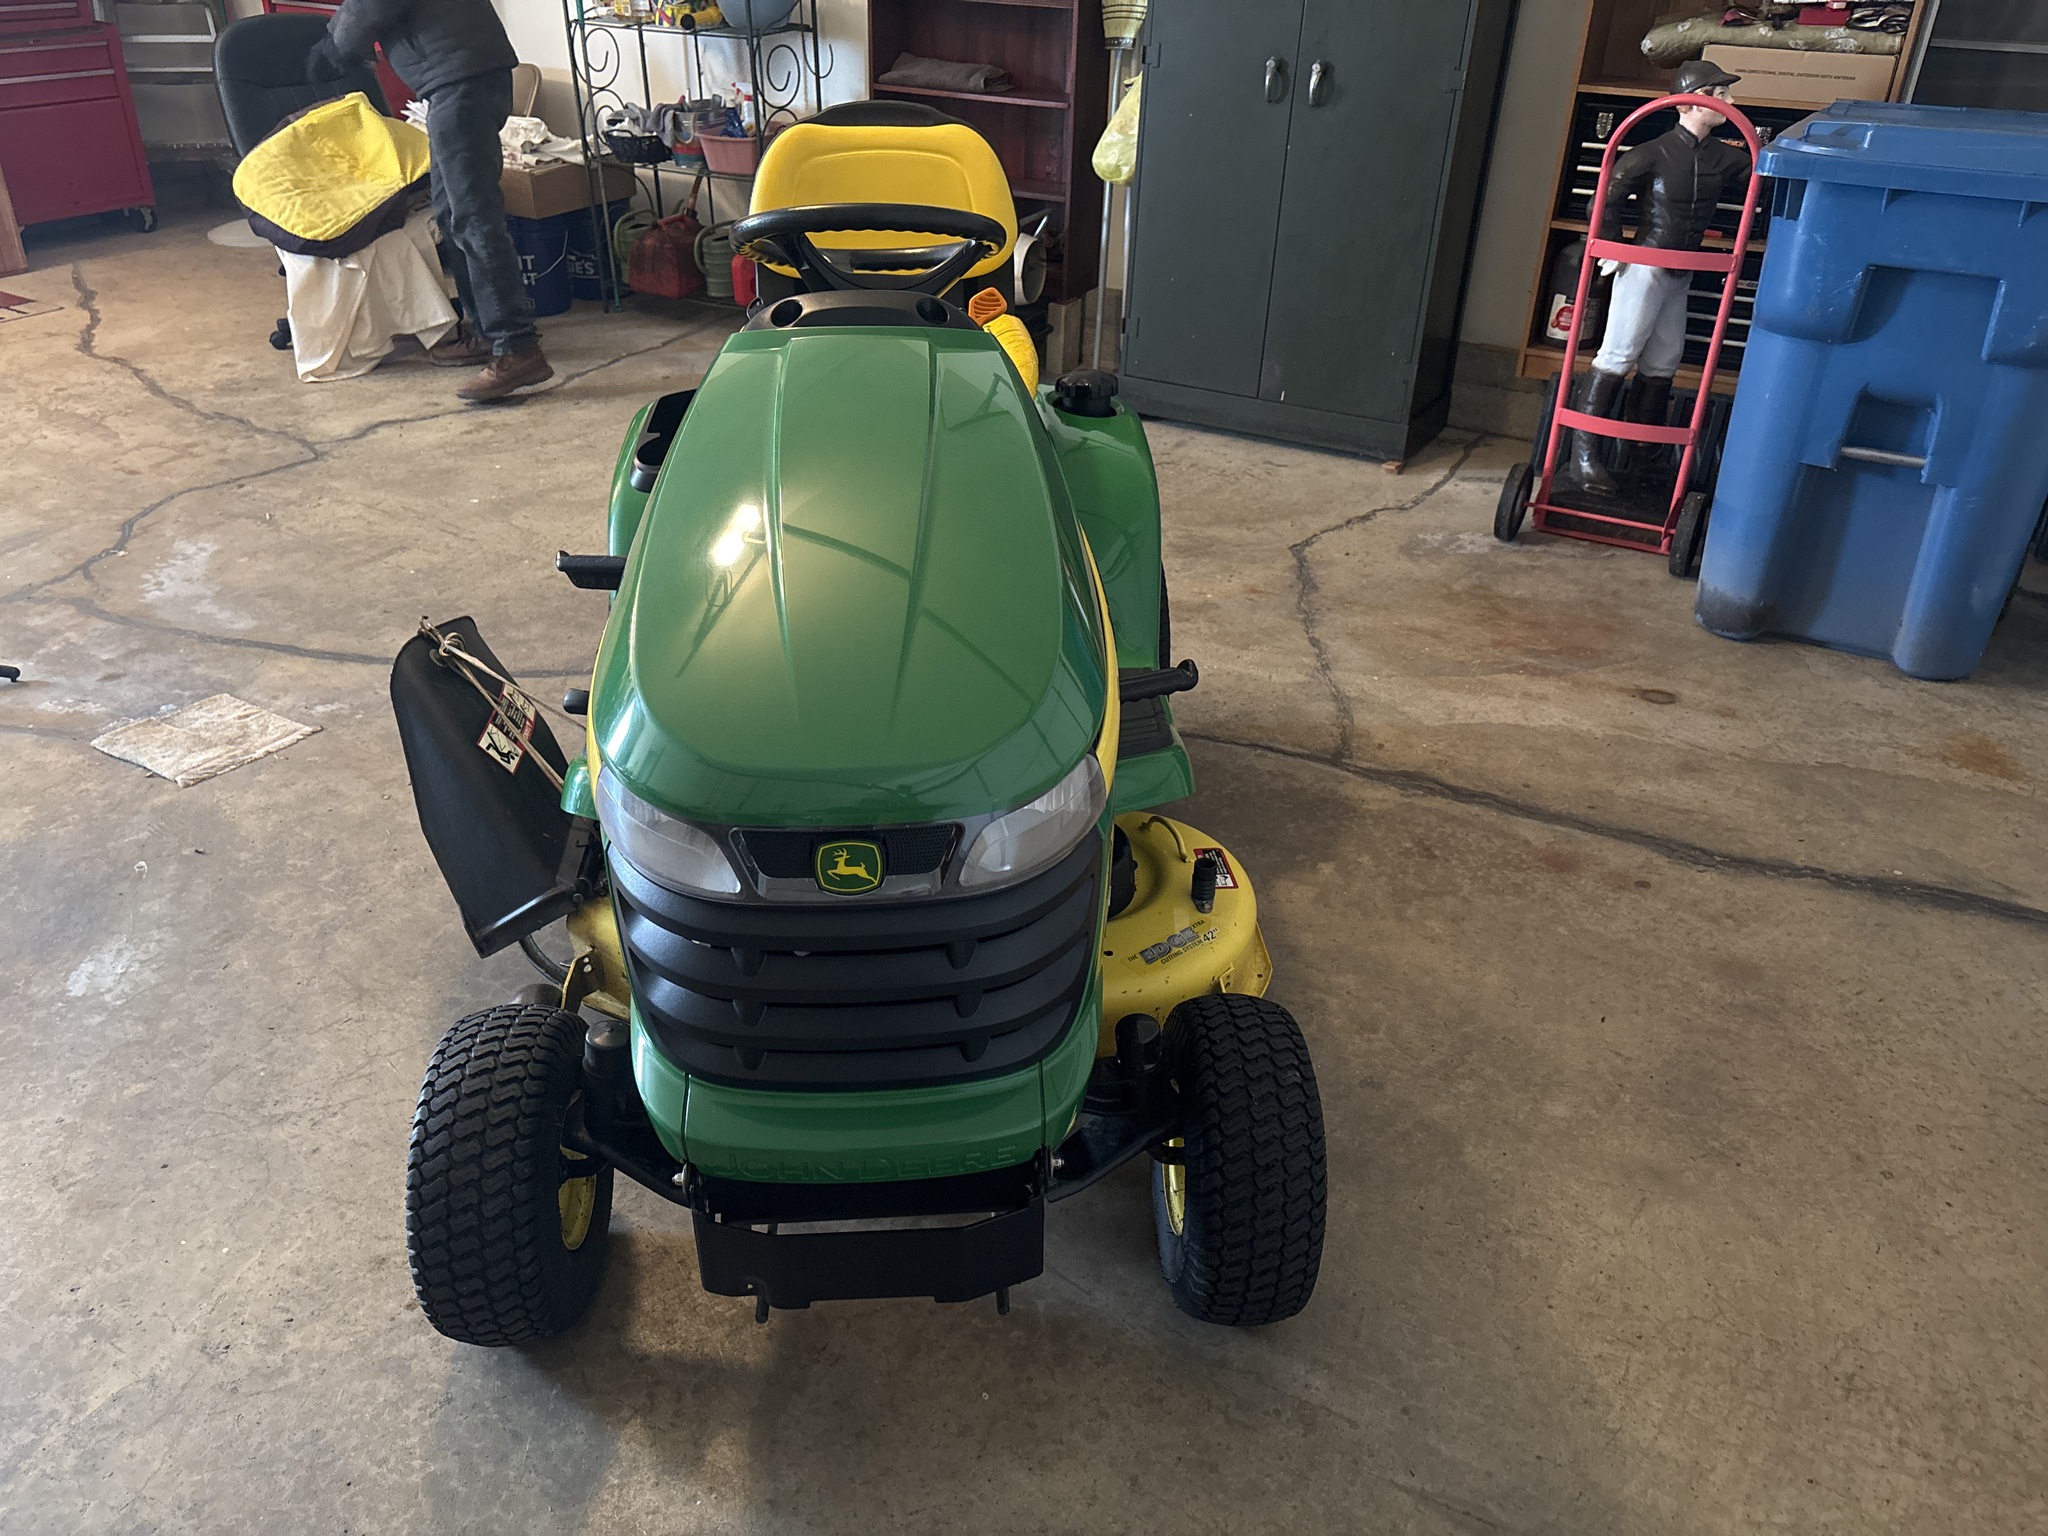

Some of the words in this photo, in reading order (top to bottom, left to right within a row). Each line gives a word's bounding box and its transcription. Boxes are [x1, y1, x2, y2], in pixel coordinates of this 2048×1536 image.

[1127, 953, 1139, 962] THE
[1139, 927, 1198, 964] EDGE
[1191, 919, 1206, 929] XTRA
[1160, 949, 1184, 965] CUTTING
[1182, 938, 1204, 953] SYSTEM
[713, 1153, 845, 1182] JOHN
[859, 1145, 1017, 1180] DEERE
